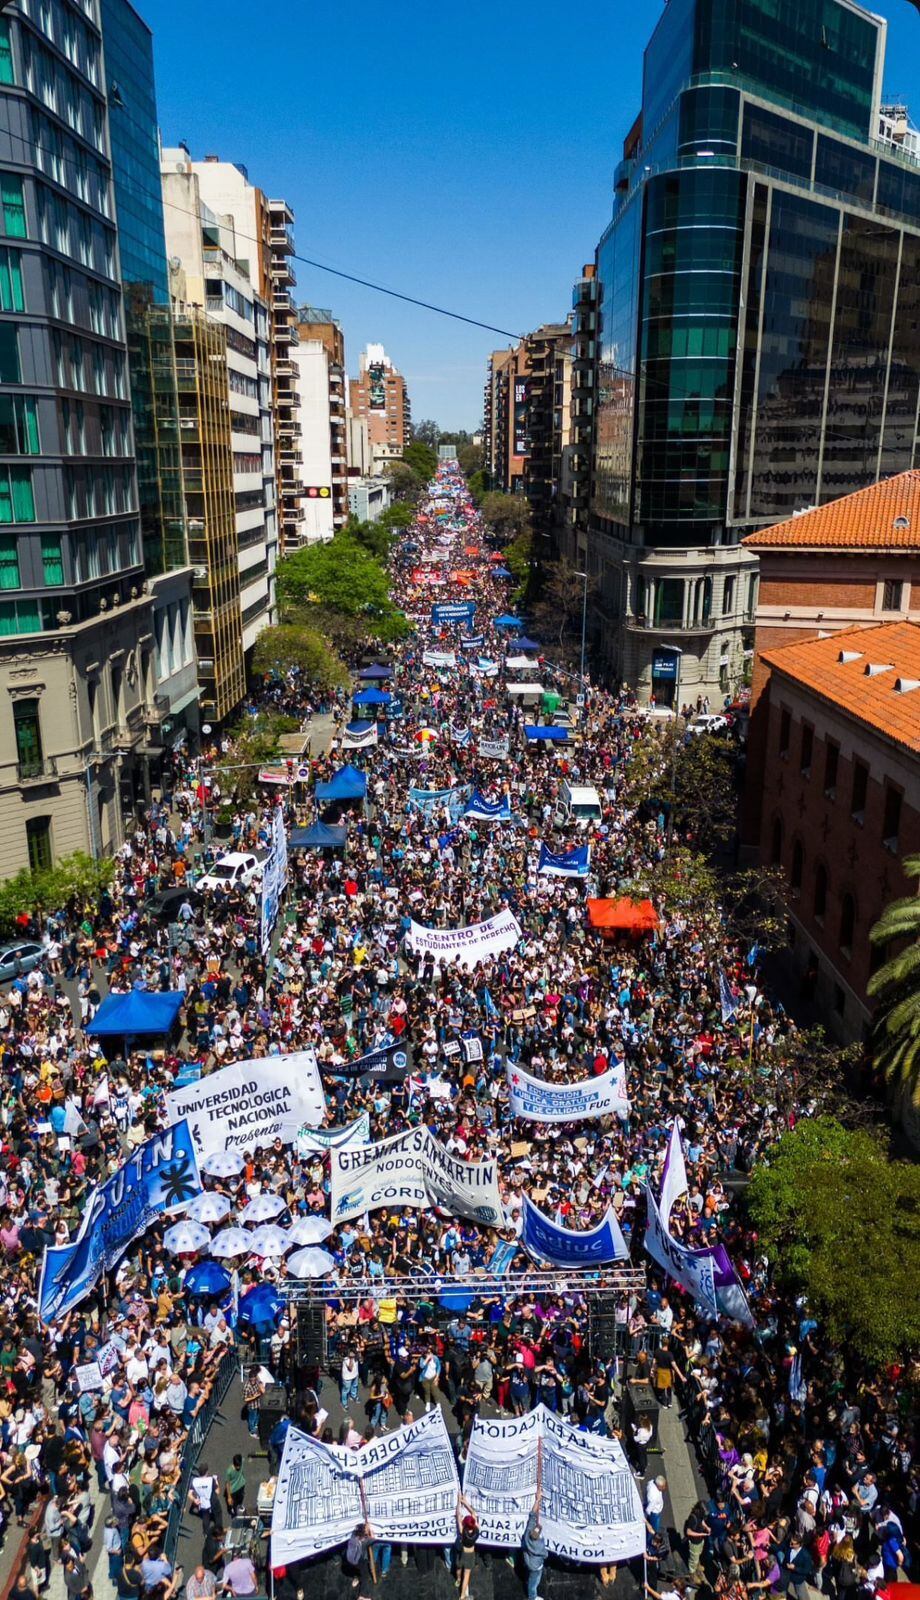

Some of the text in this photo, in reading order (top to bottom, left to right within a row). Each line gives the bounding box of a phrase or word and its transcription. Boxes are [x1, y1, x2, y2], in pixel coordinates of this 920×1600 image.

[415, 936, 467, 950] ESTUDIANTES
[481, 922, 517, 941] DERECHO
[426, 921, 494, 942] CENTRO DE
[176, 1080, 258, 1116] UNIVERSIDAD
[208, 1086, 291, 1122] TECNOLOGICA
[525, 1103, 585, 1115] Y DE CALIDAD
[552, 1093, 597, 1106] GRATUITA
[589, 1099, 611, 1111] FUC
[228, 1103, 291, 1131] NACIONAL
[338, 1135, 409, 1171] GREMIAL
[376, 1158, 453, 1191] NODOCENTES
